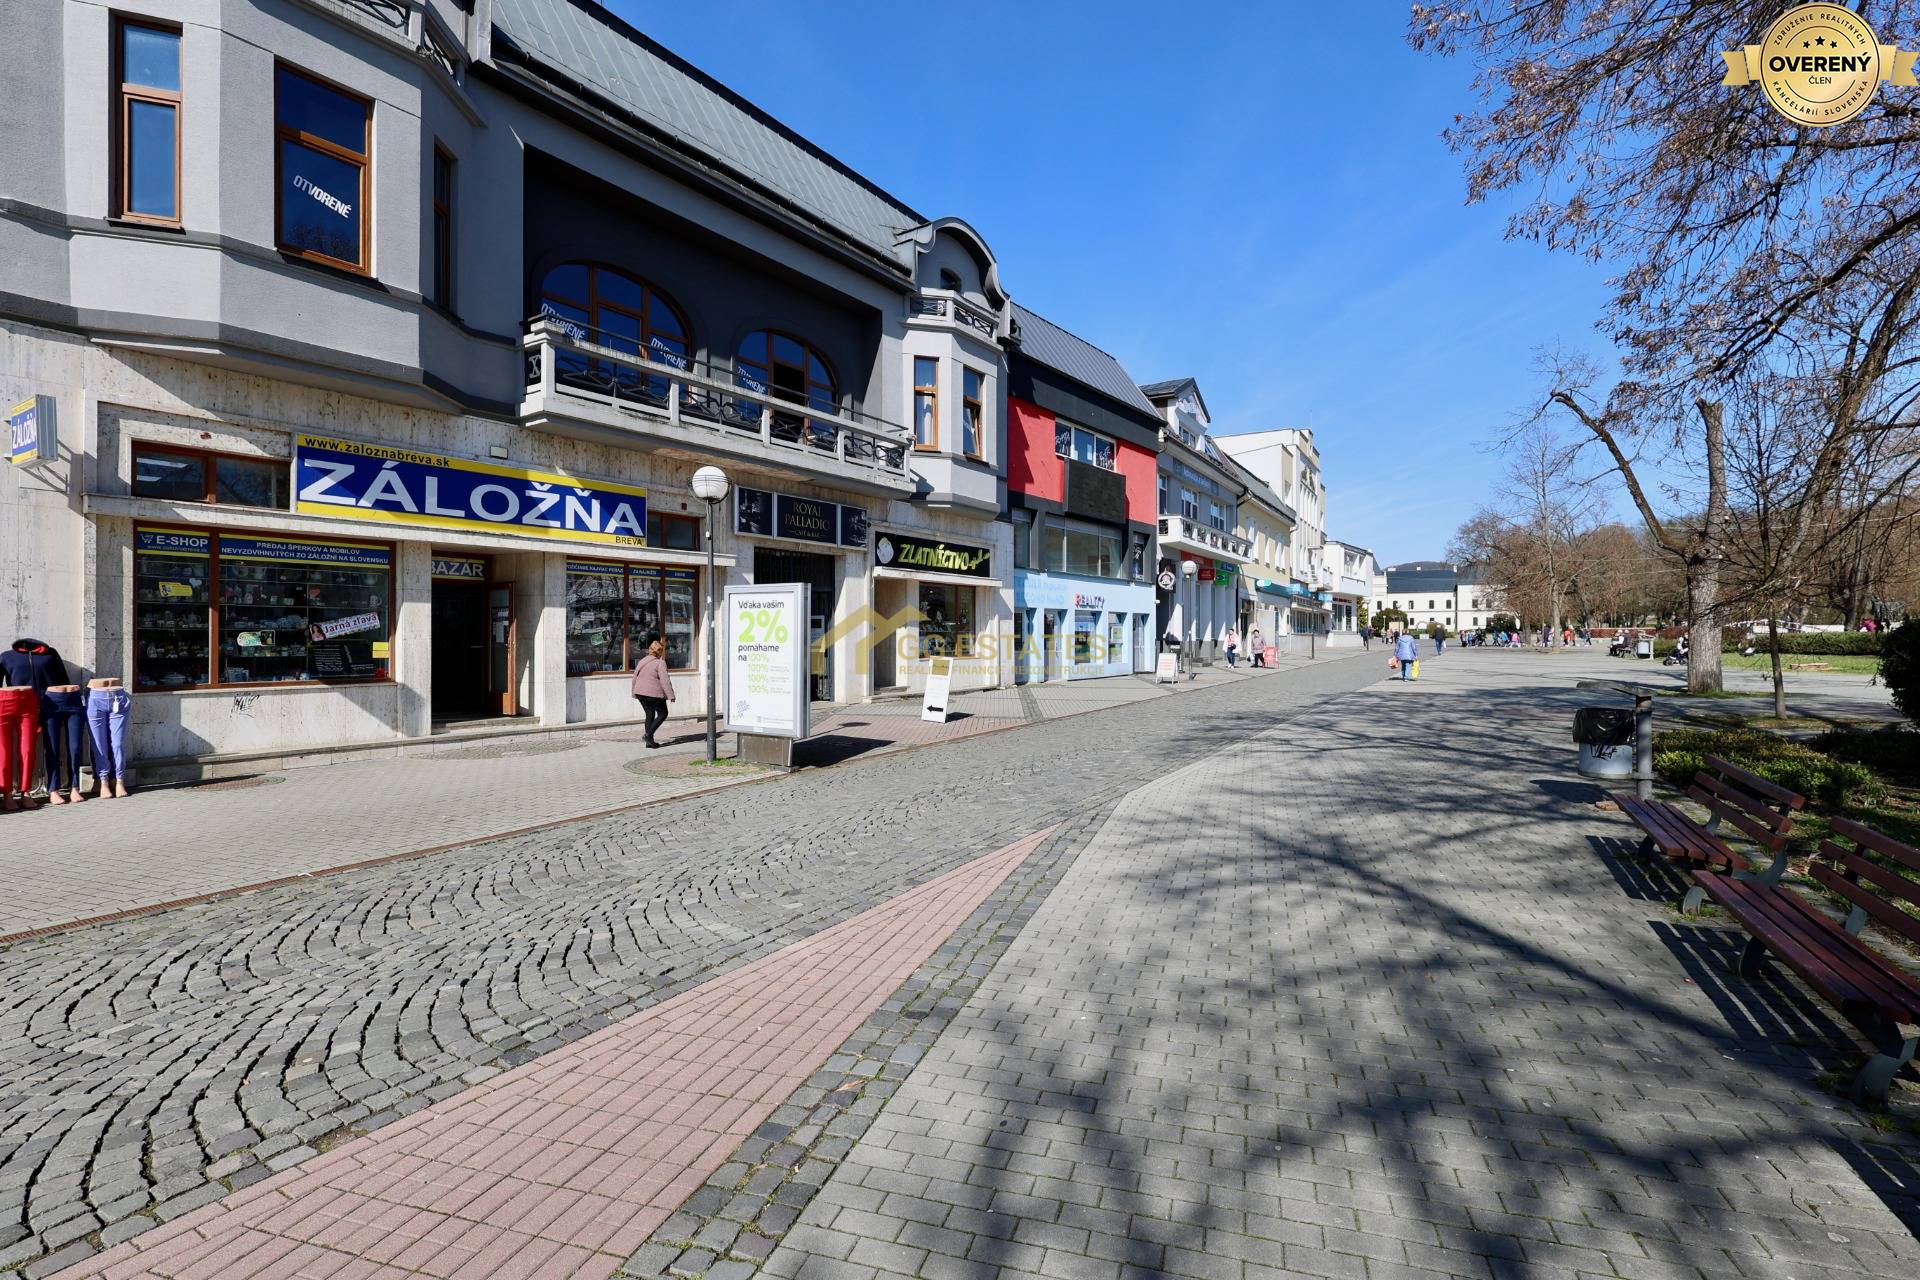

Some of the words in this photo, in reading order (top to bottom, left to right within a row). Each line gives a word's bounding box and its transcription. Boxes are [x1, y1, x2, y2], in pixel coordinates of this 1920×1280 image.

[293, 175, 352, 219] OTVORENÉ
[304, 437, 451, 467] www.zaloznabreva.sk
[299, 458, 645, 537] ZÁLOŽŇA
[793, 501, 822, 517] ROYAL
[156, 535, 209, 547] E-SHOP
[615, 536, 644, 546] BREVA
[256, 542, 286, 550] PREDAJ
[287, 543, 322, 553] ŠPERKOV
[329, 547, 360, 555] MOBILOV
[349, 555, 389, 564] SLOVENSKU
[898, 543, 970, 571] ZLATNÍCTVO
[738, 599, 761, 609] Vďaka
[325, 620, 351, 634] Jarná
[738, 608, 789, 644] 2%
[738, 654, 748, 662] na
